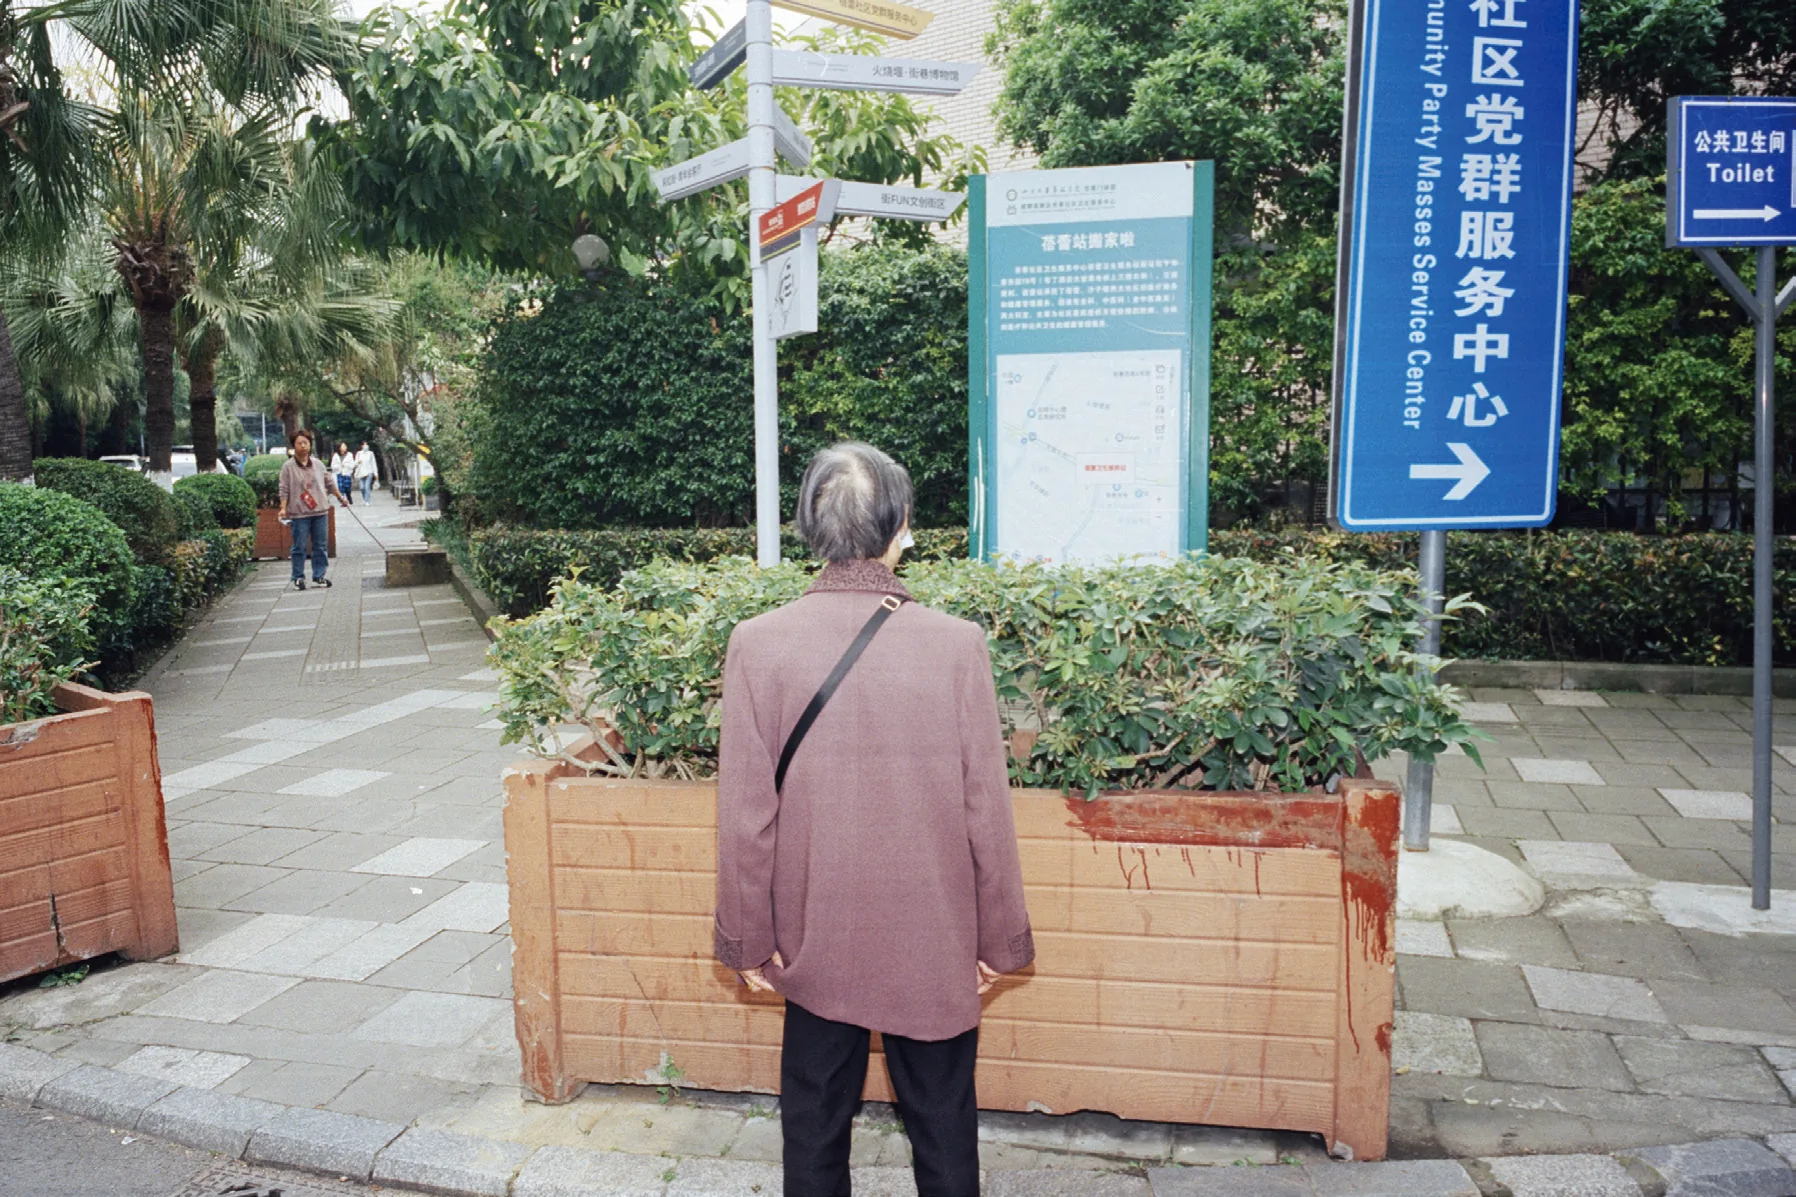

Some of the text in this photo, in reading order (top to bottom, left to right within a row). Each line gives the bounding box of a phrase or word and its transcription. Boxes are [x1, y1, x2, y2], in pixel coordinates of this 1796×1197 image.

[1415, 83, 1448, 149] Party
[1694, 130, 1786, 154] 公共卫生间
[881, 193, 946, 209] 街FUN文创街区
[1413, 156, 1442, 247] Masses
[1706, 163, 1775, 183] Toilet
[1408, 254, 1437, 343] Service
[1403, 350, 1432, 430] Center
